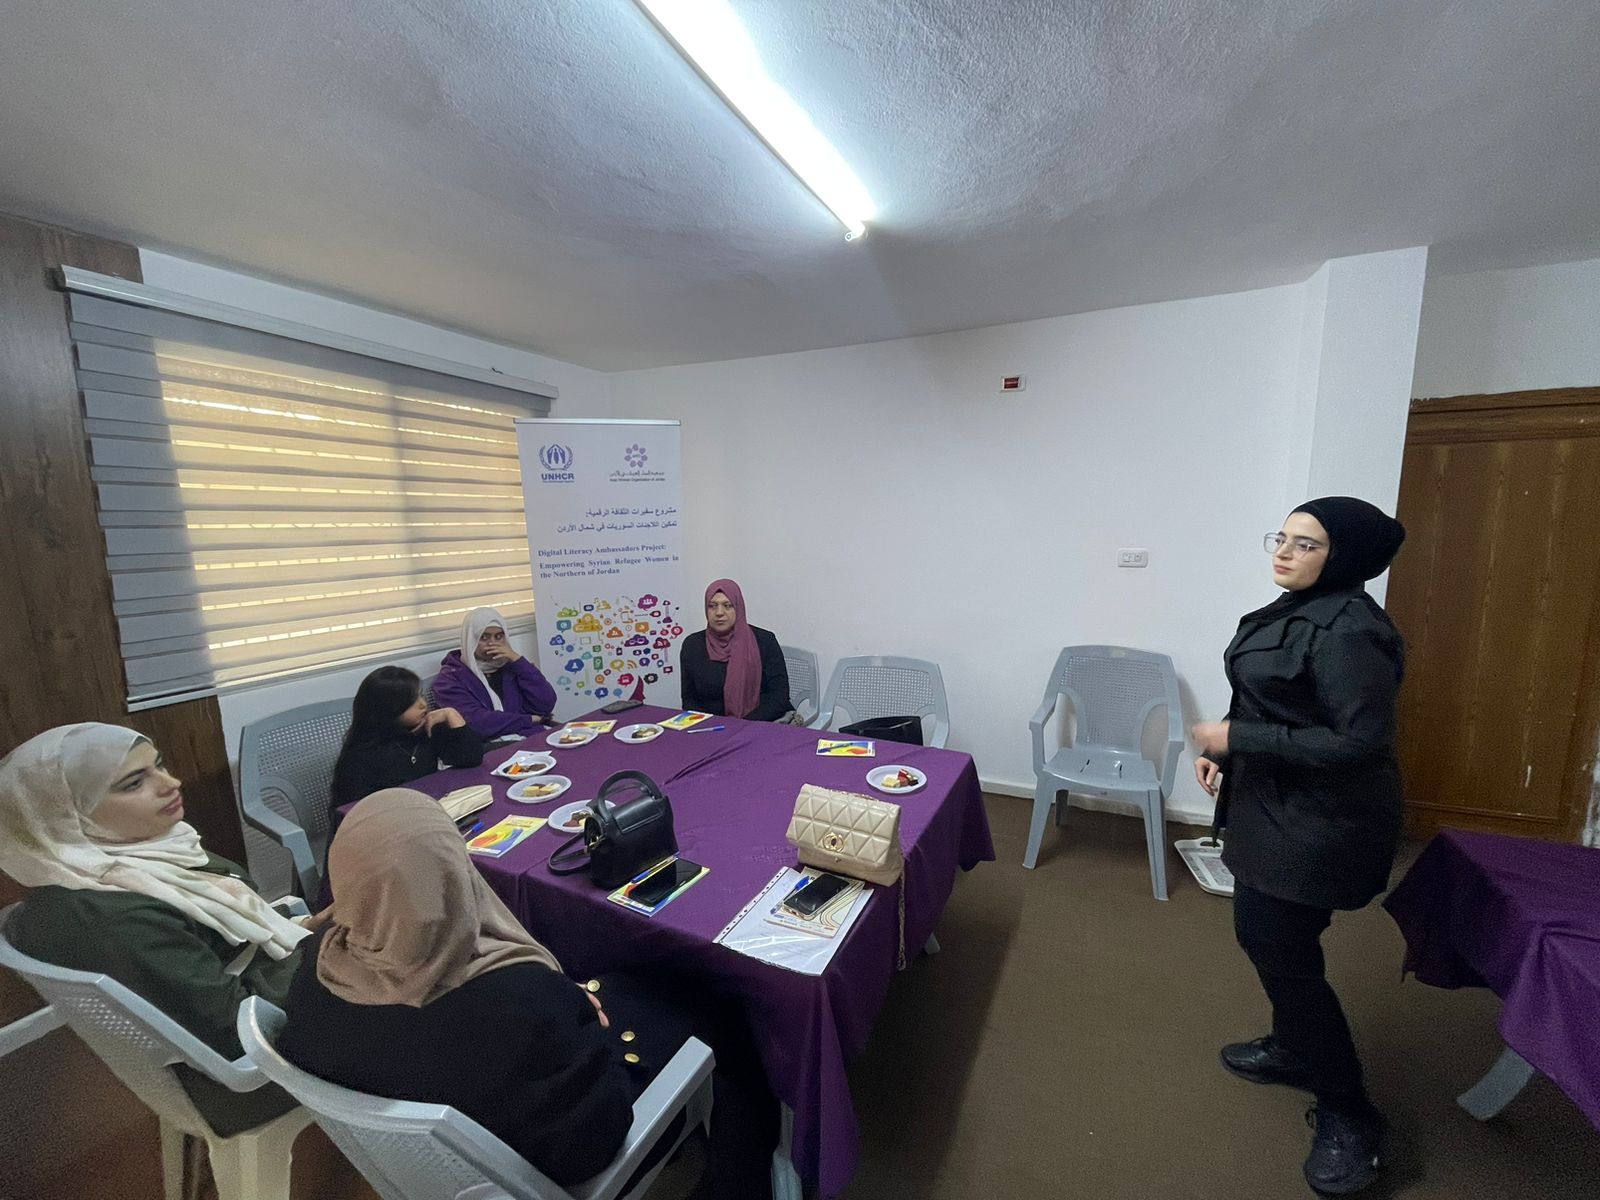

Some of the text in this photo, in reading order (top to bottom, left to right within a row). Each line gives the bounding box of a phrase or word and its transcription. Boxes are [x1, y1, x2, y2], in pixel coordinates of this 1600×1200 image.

[541, 472, 575, 480] UNHCR
[655, 507, 677, 516] مشروع
[578, 523, 595, 532] شمال
[595, 521, 605, 532] في
[538, 549, 562, 557] Digital
[564, 548, 593, 556] Literacy
[540, 561, 585, 570] Empowering
[588, 559, 611, 567] Syrian
[540, 567, 620, 579] the Northern of Jordan
